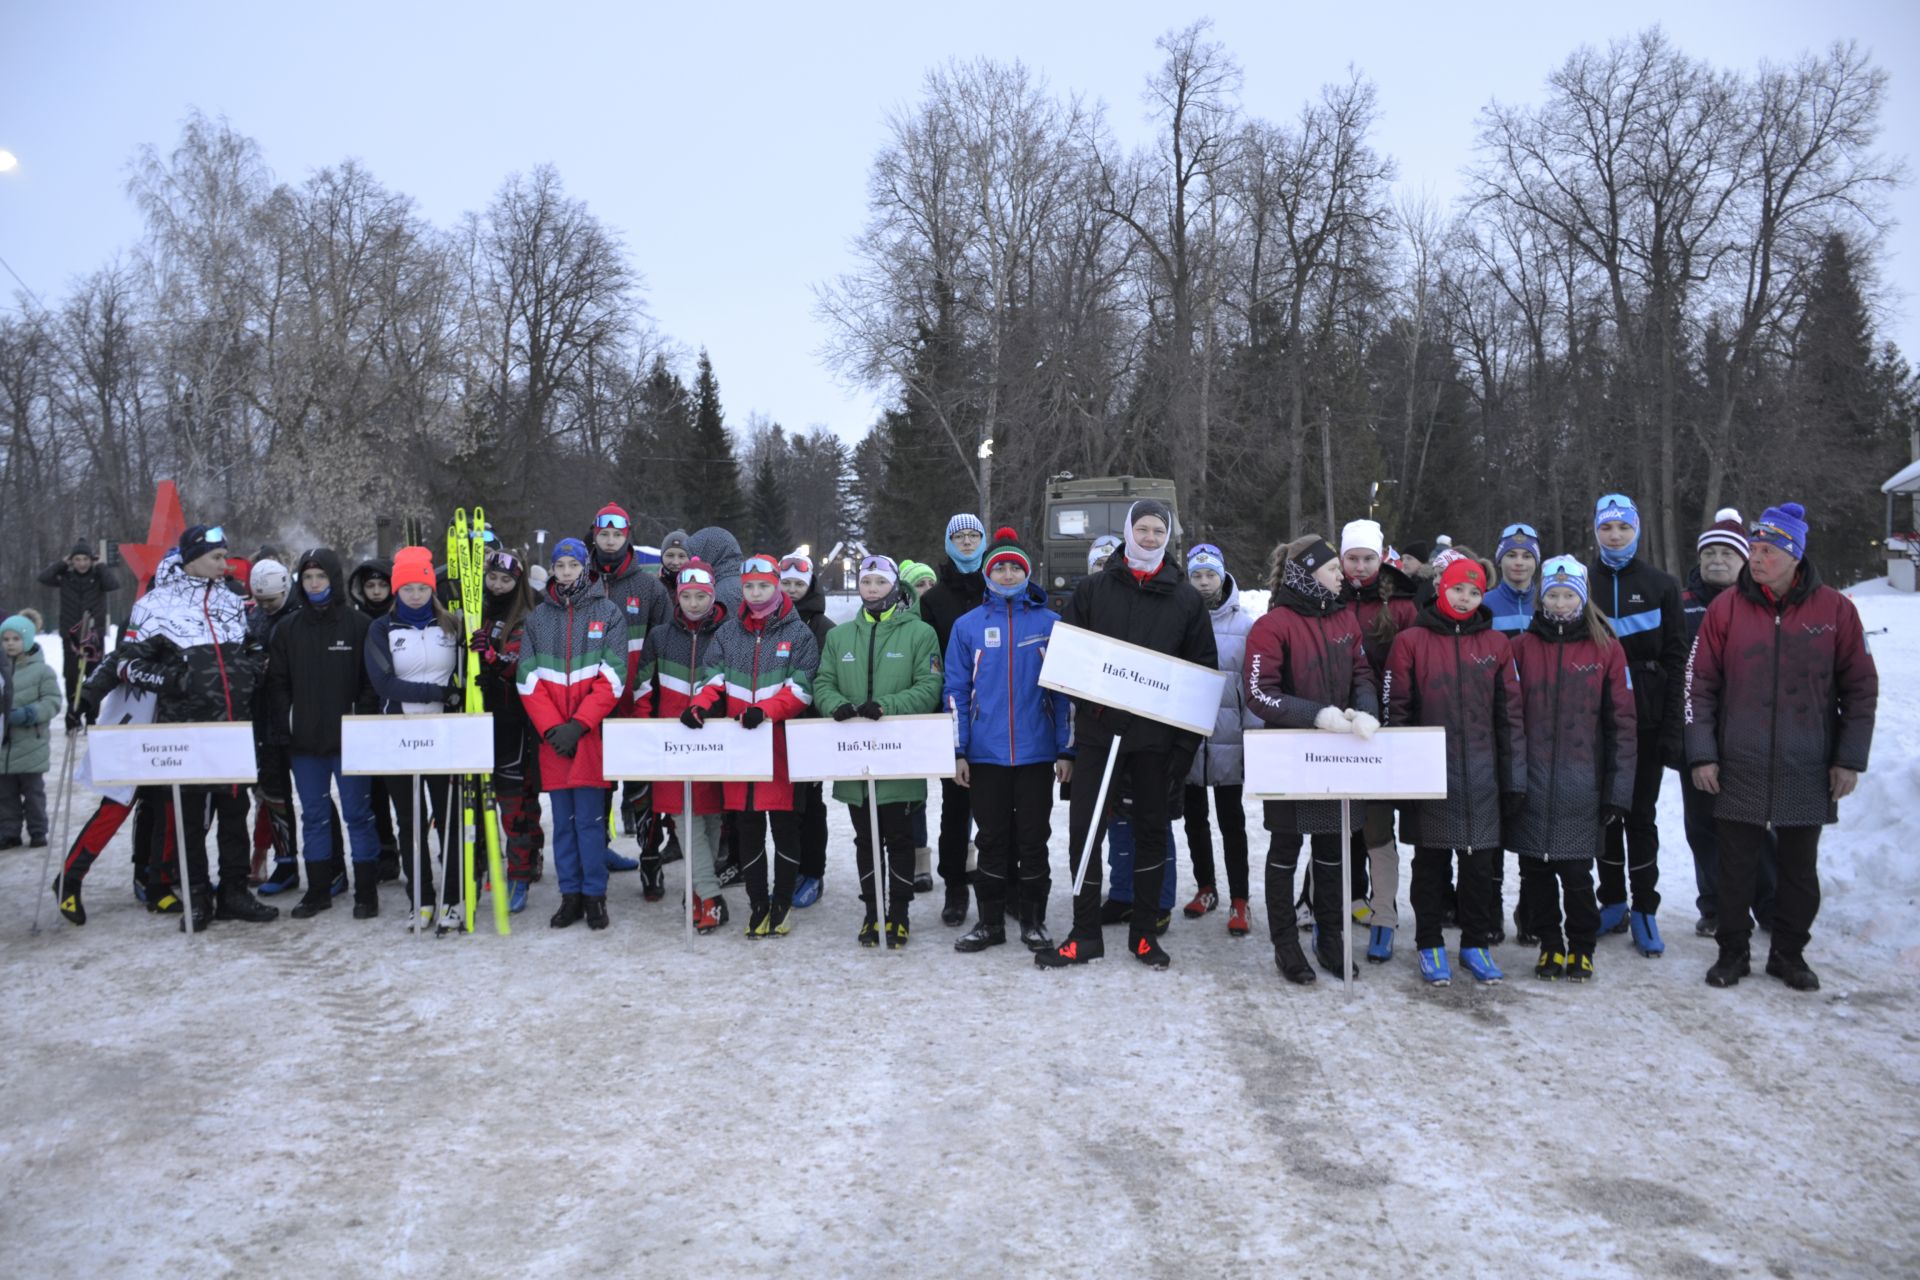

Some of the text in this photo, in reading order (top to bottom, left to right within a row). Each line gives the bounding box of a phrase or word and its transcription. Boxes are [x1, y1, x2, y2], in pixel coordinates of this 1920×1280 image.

[460, 544, 474, 615] FISCHER
[472, 542, 483, 614] FISCHER
[1102, 662, 1170, 692] Наб.Челны
[142, 743, 190, 753] Богатые
[398, 738, 435, 750] Агрыз
[664, 741, 724, 755] Бугульма
[151, 756, 183, 767] Сабы
[1305, 752, 1383, 764] Нижнекамск
